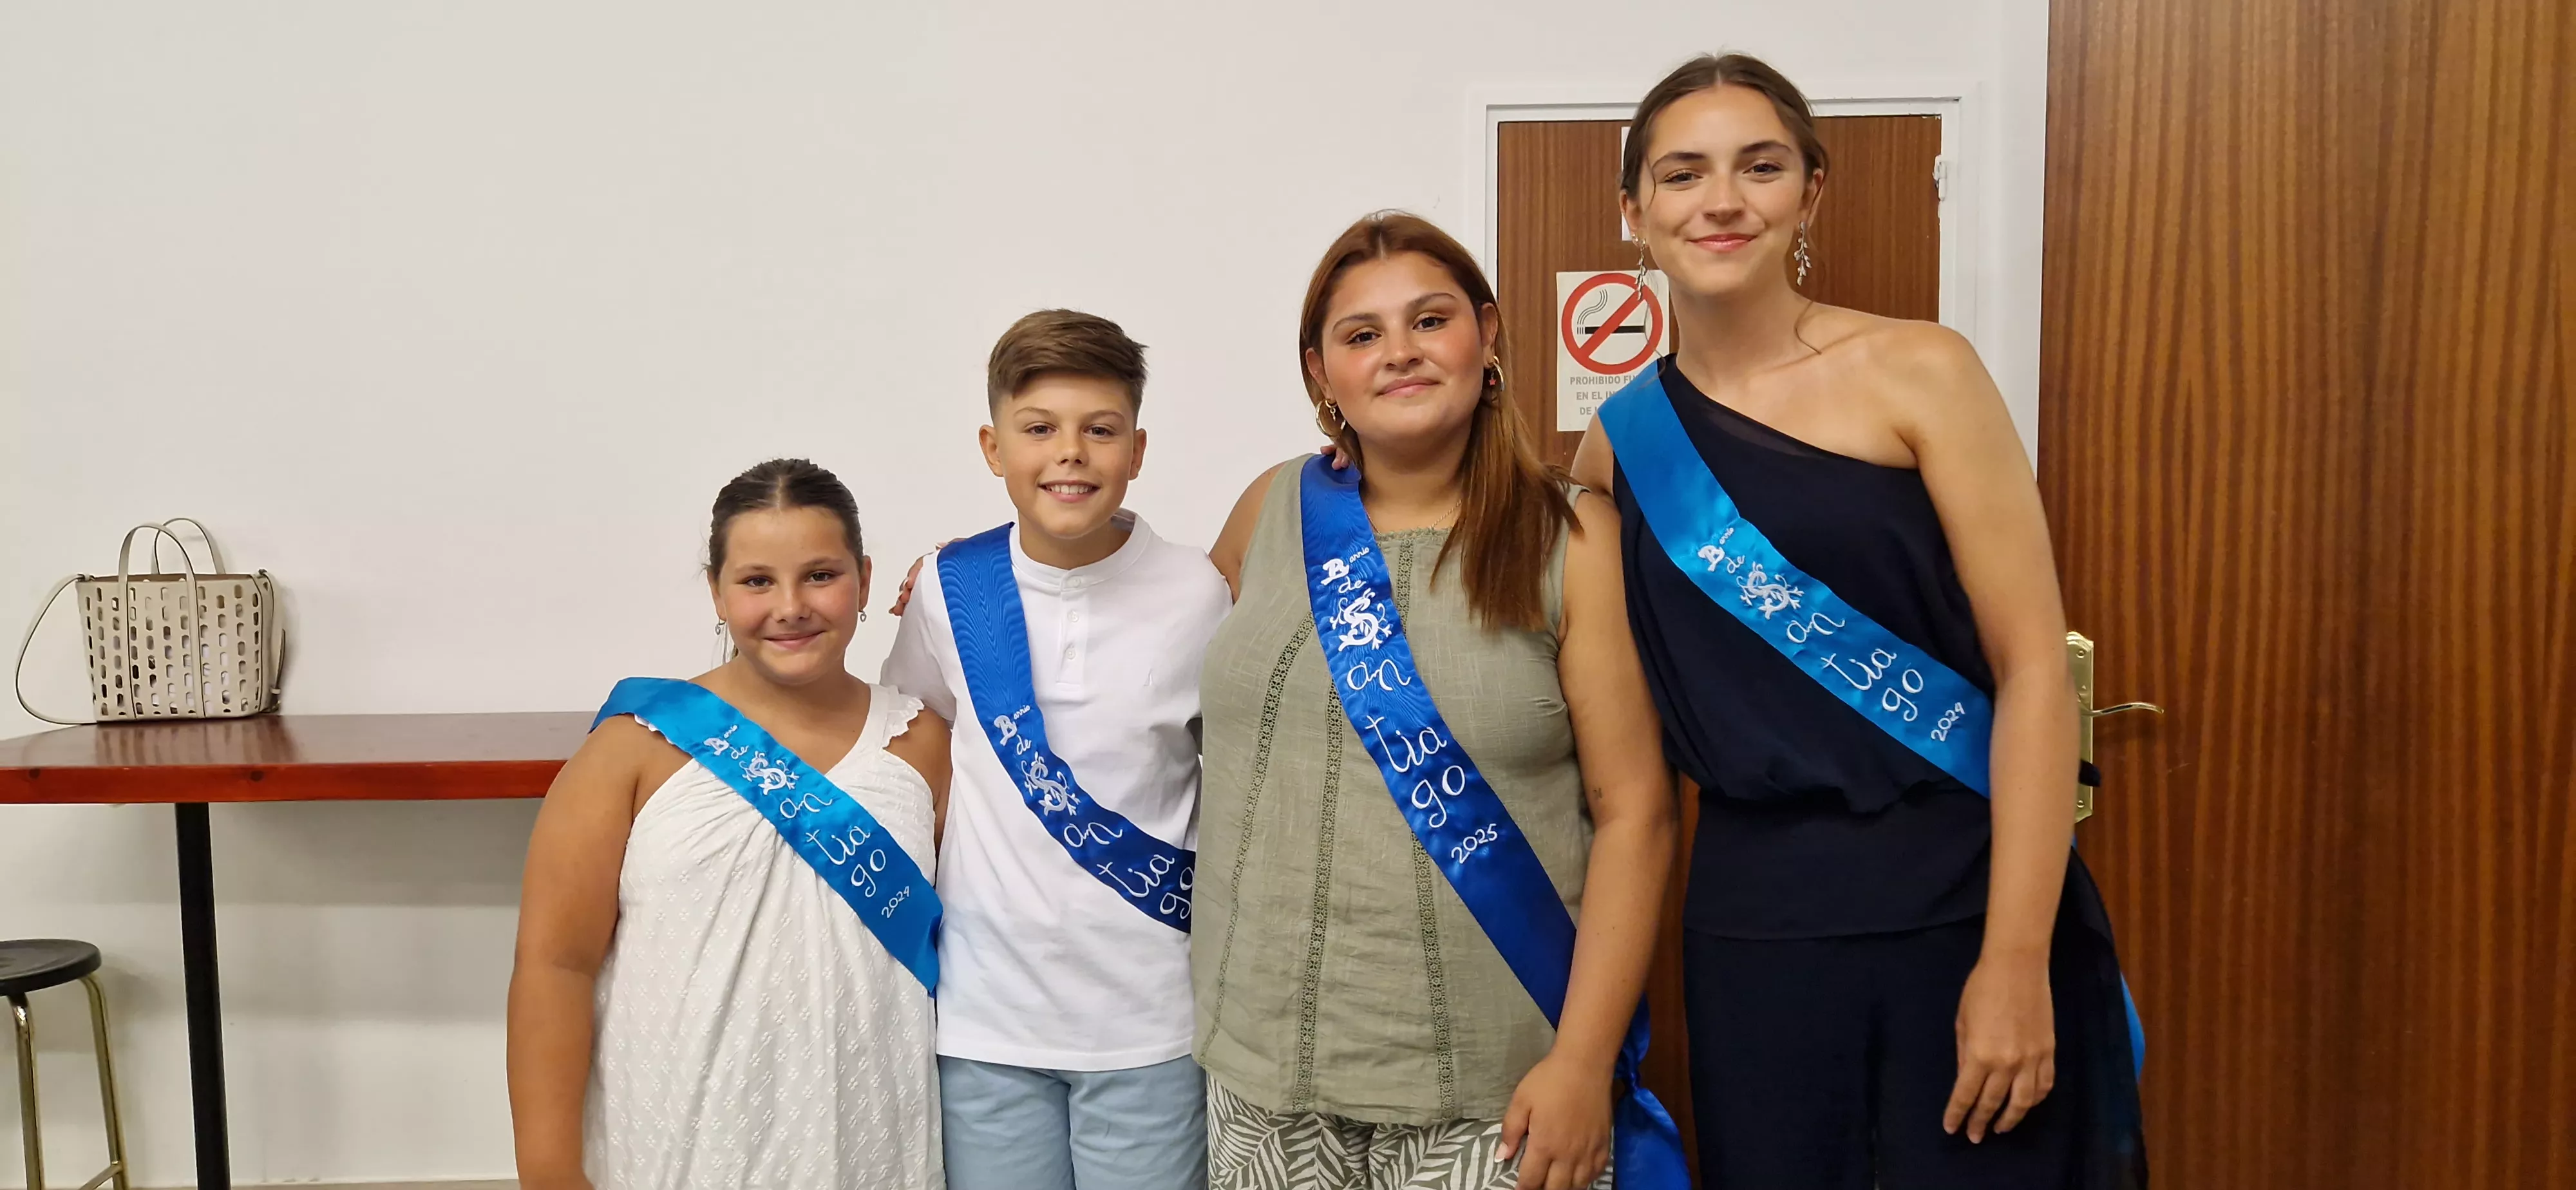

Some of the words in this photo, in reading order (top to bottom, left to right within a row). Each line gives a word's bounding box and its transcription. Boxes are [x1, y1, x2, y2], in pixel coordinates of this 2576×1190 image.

[1570, 375, 1620, 385] PROHIBIDO
[1576, 392, 1588, 401] EN
[1591, 391, 1603, 400] EL
[1579, 406, 1592, 415] DE
[1725, 554, 1745, 573] de
[1338, 578, 1366, 594] de
[1931, 702, 1965, 742] 2024
[729, 744, 749, 760] de
[1016, 735, 1032, 755] de
[1451, 824, 1499, 864] 2025
[880, 885, 911, 918] 2024
